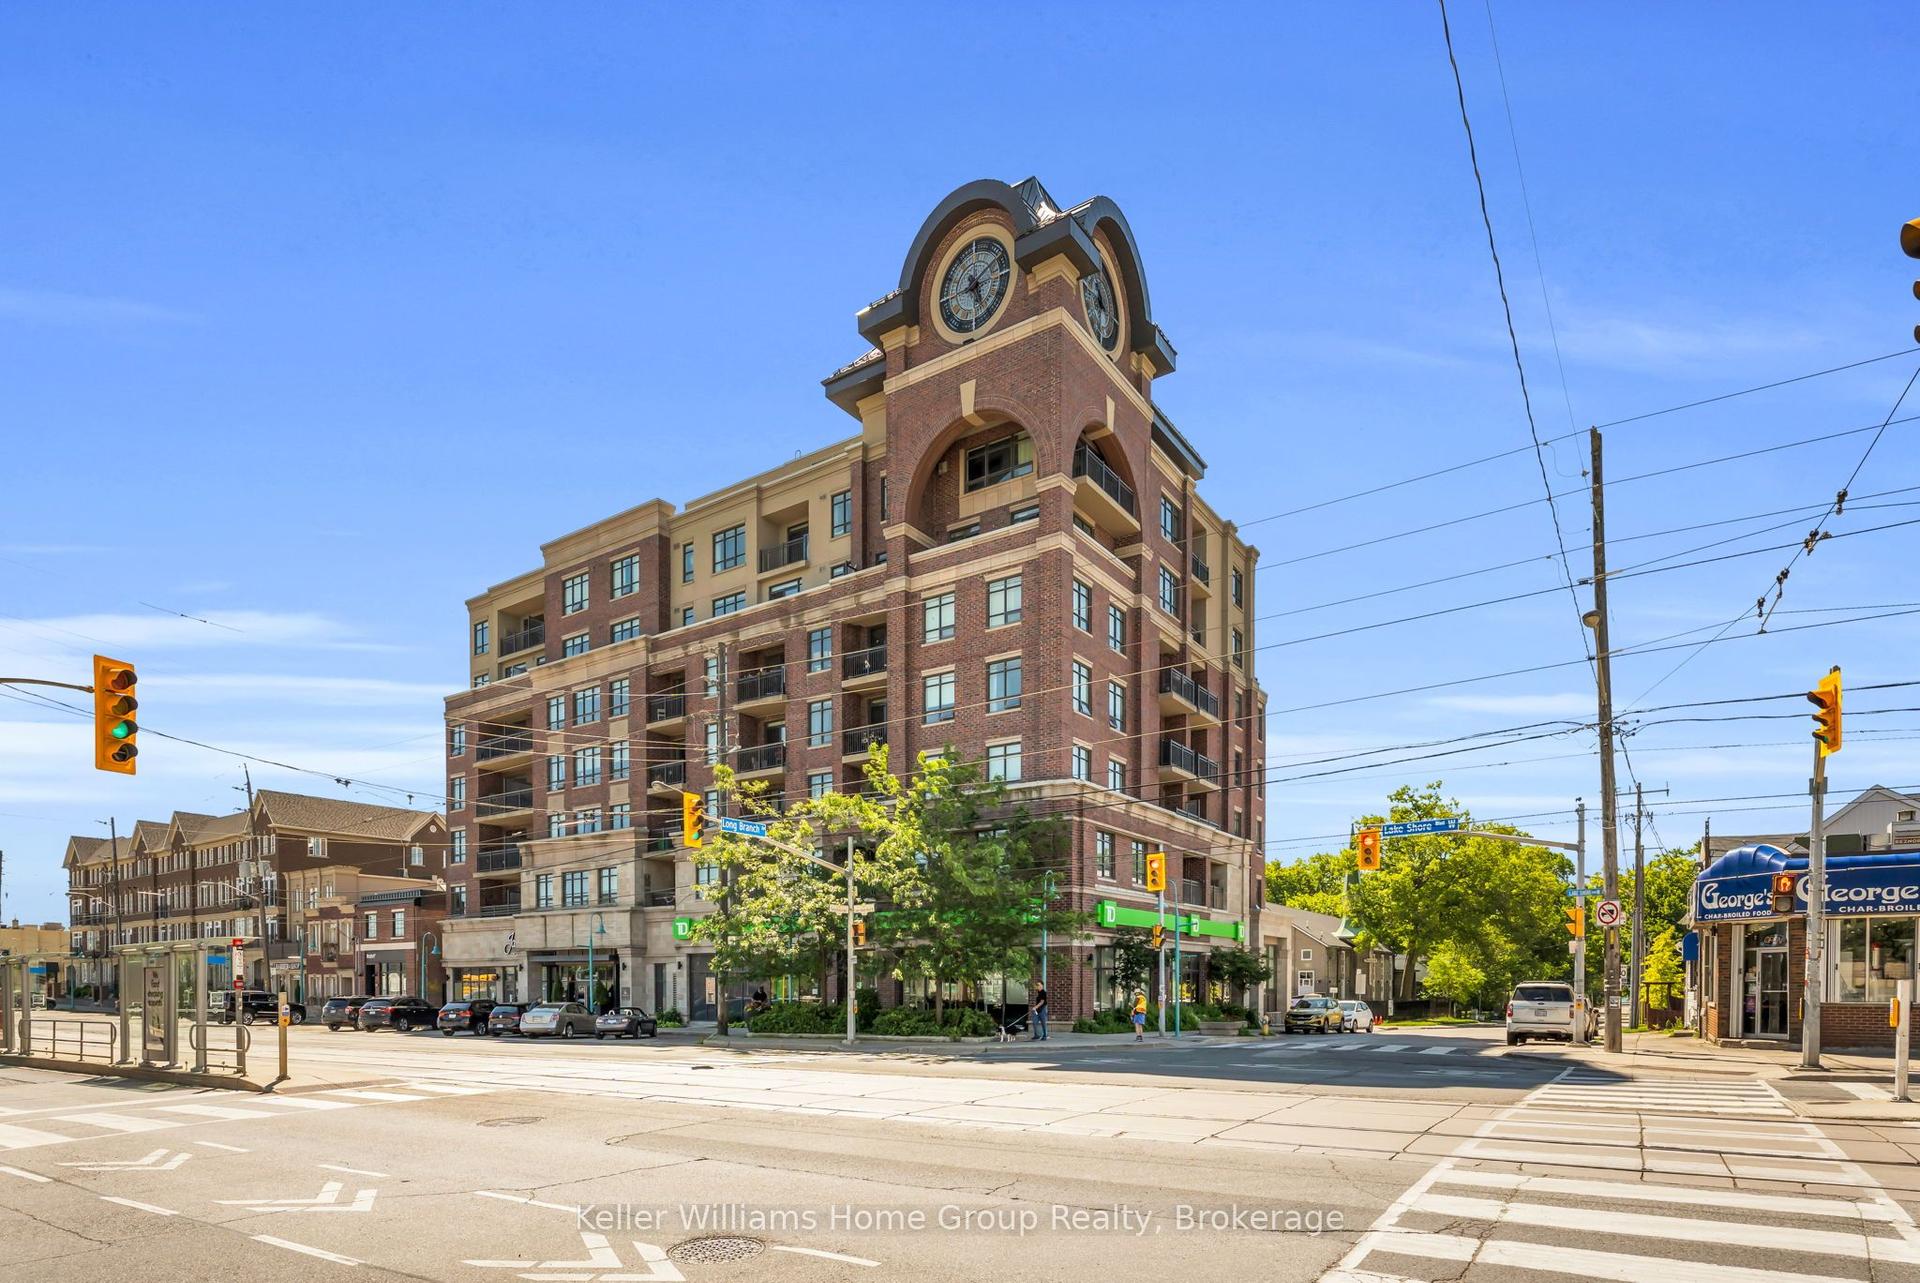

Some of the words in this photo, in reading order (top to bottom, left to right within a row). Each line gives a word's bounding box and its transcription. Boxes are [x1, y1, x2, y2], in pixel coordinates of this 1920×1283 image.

[723, 818, 738, 831] Long
[739, 821, 760, 833] Branch
[1384, 825, 1404, 834] Lake
[1406, 822, 1432, 833] Shore
[1447, 819, 1456, 829] W
[1701, 882, 1773, 910] George's
